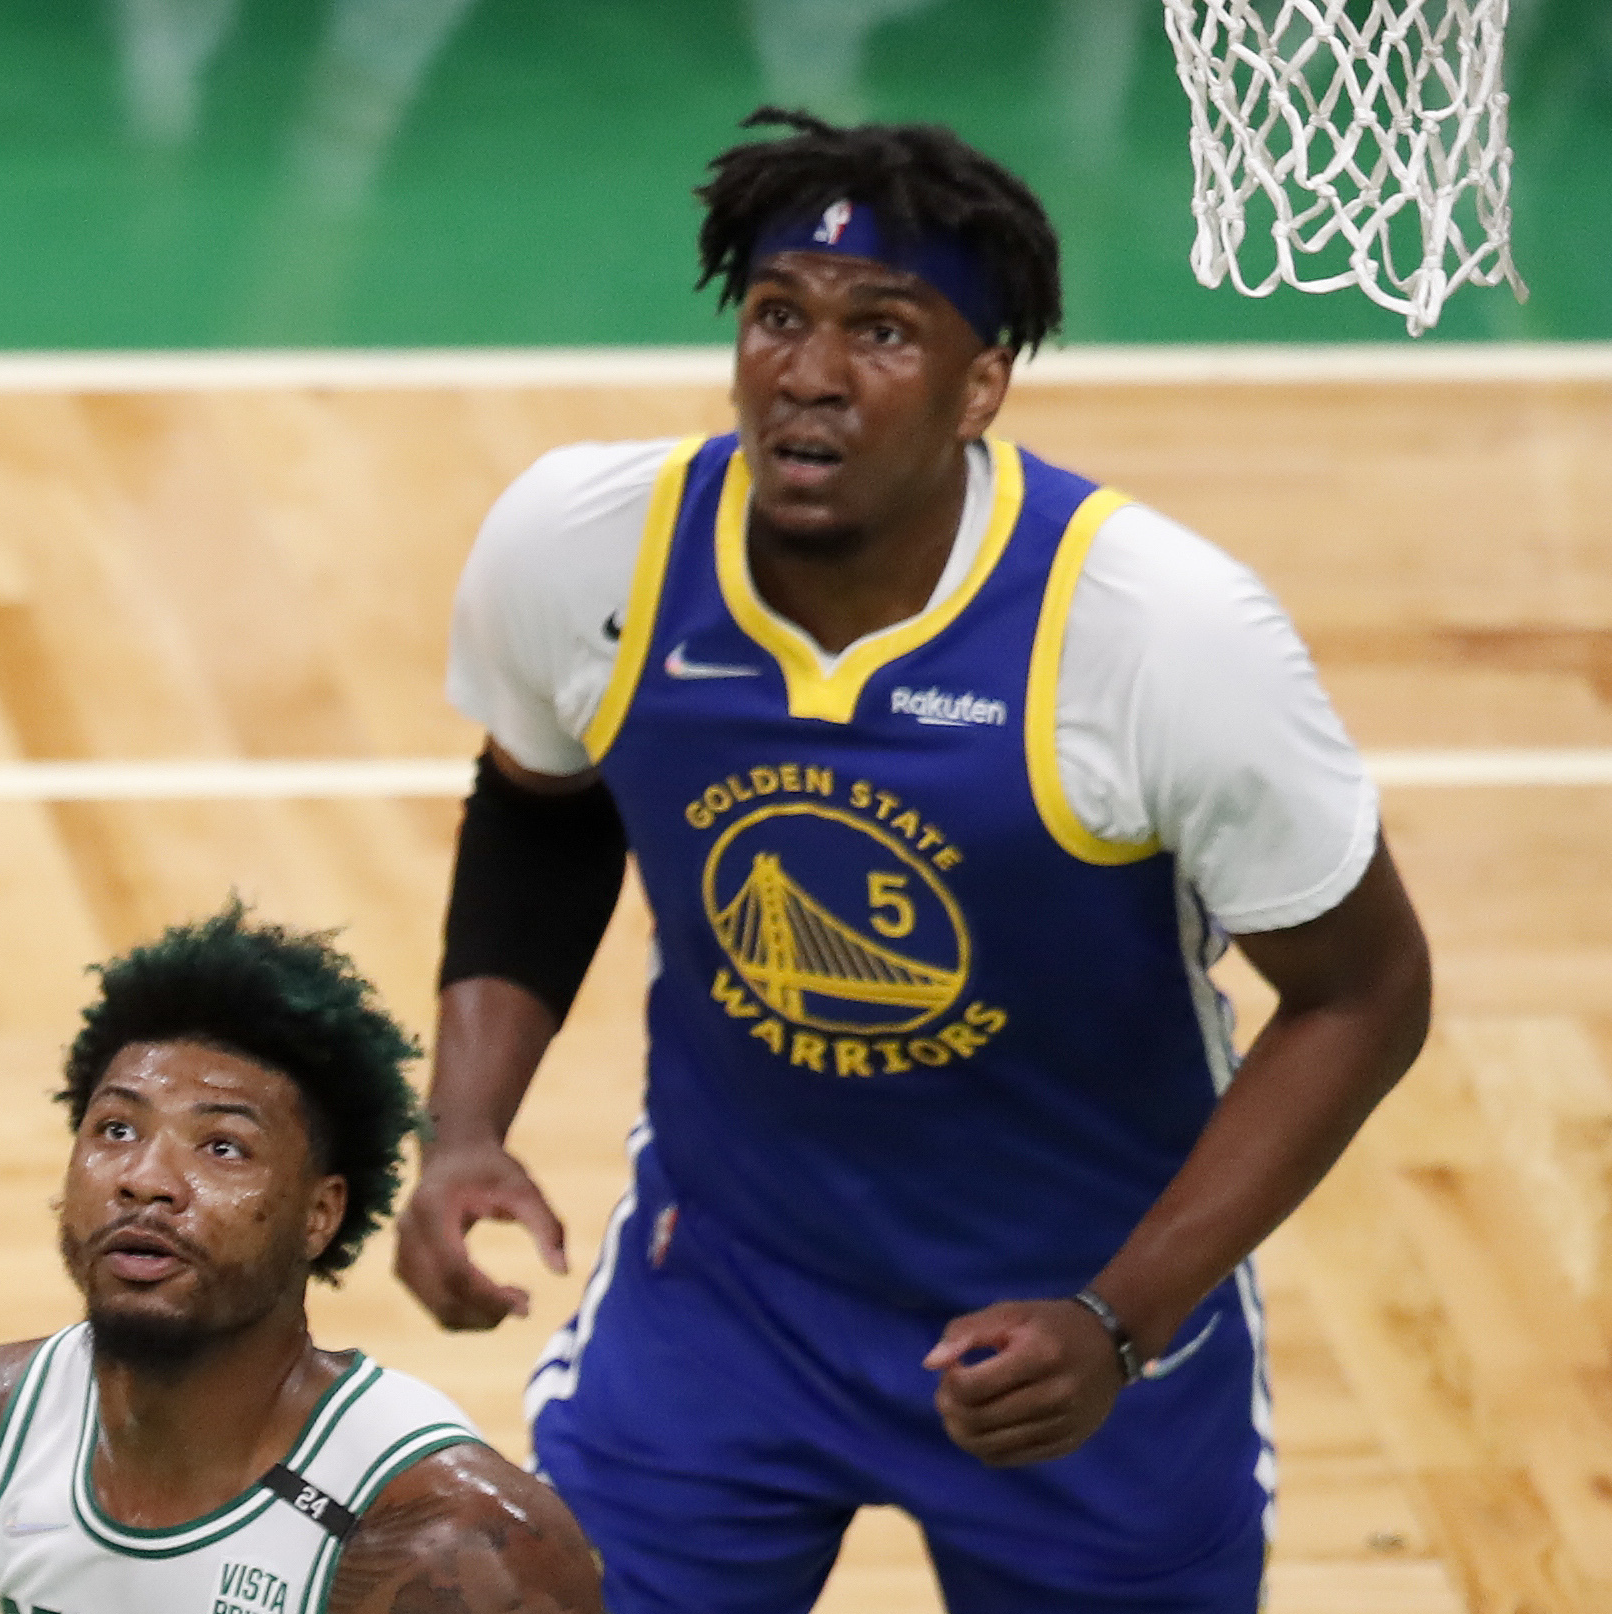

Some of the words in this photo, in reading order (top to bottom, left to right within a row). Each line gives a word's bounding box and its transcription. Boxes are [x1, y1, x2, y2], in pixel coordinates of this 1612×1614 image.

[891, 685, 1007, 726] Rakuten
[685, 763, 834, 829] GOLDEN
[850, 779, 963, 871] STATE
[866, 871, 915, 938] 5
[709, 968, 1008, 1077] WARRIORS
[293, 1485, 330, 1520] 24
